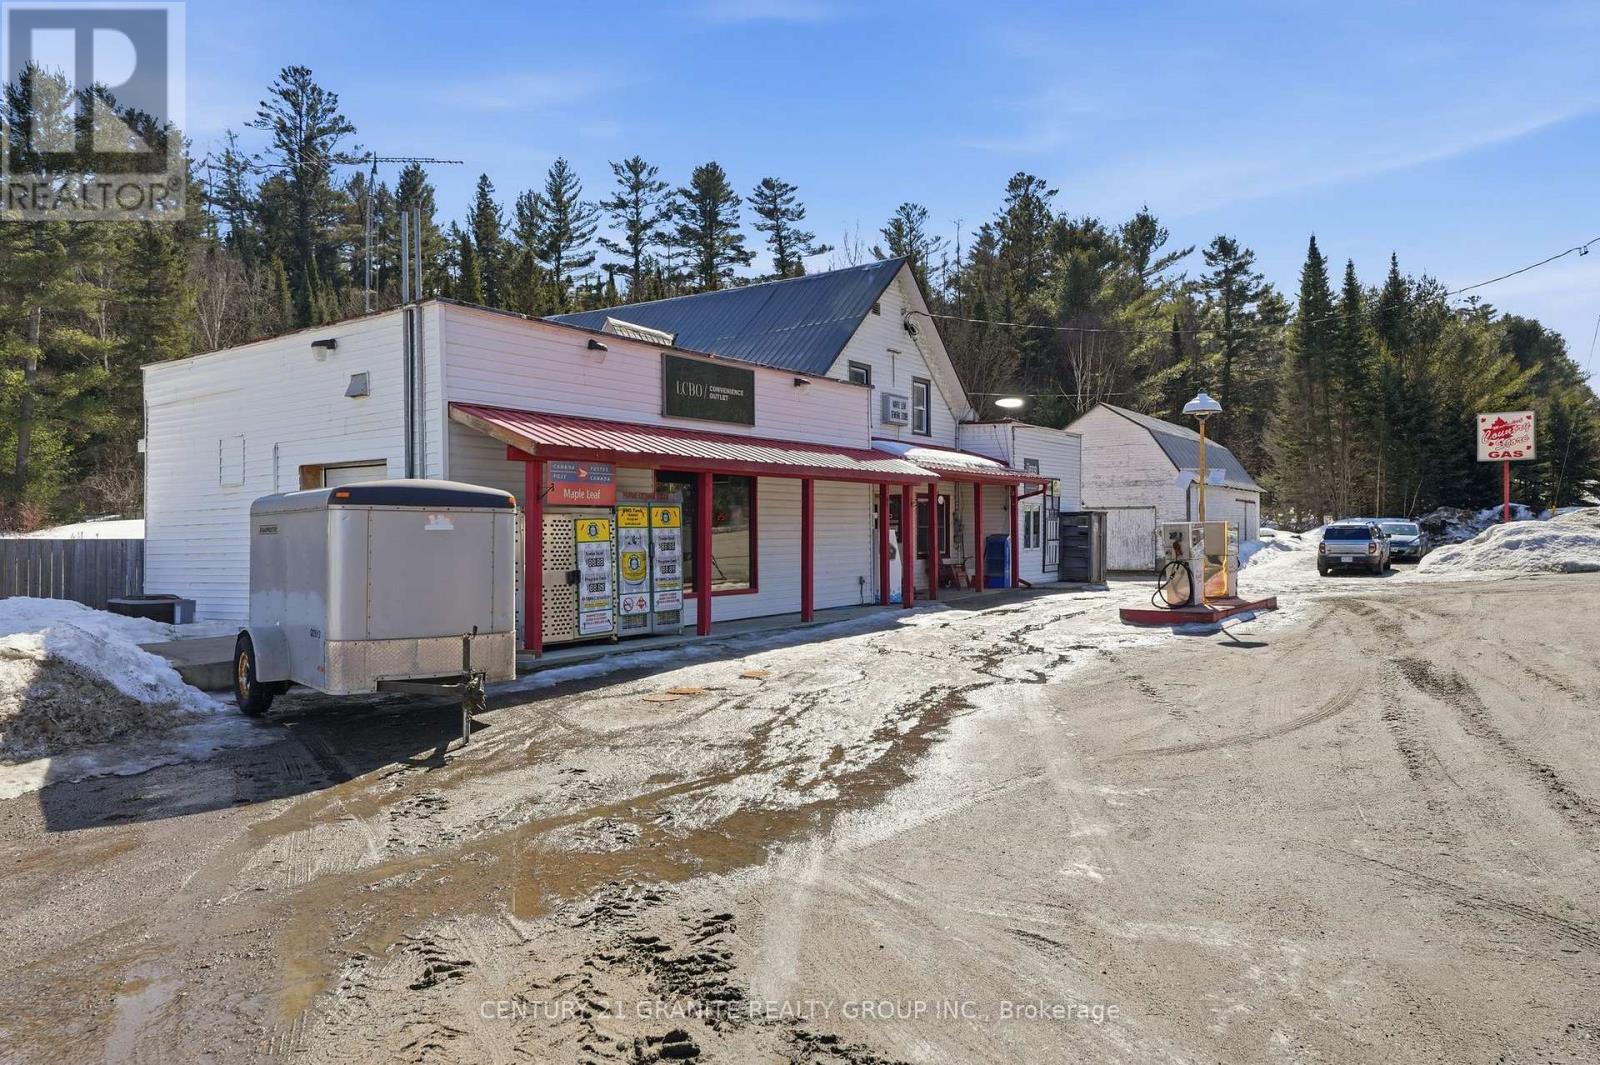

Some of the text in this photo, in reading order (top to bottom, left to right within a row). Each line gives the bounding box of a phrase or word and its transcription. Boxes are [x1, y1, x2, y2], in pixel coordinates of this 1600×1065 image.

[676, 380, 703, 397] LCBO
[709, 385, 744, 396] CONVENIENCE
[709, 393, 729, 401] OUTLET
[1488, 450, 1524, 459] GAS
[563, 488, 601, 501] Maple Leaf
